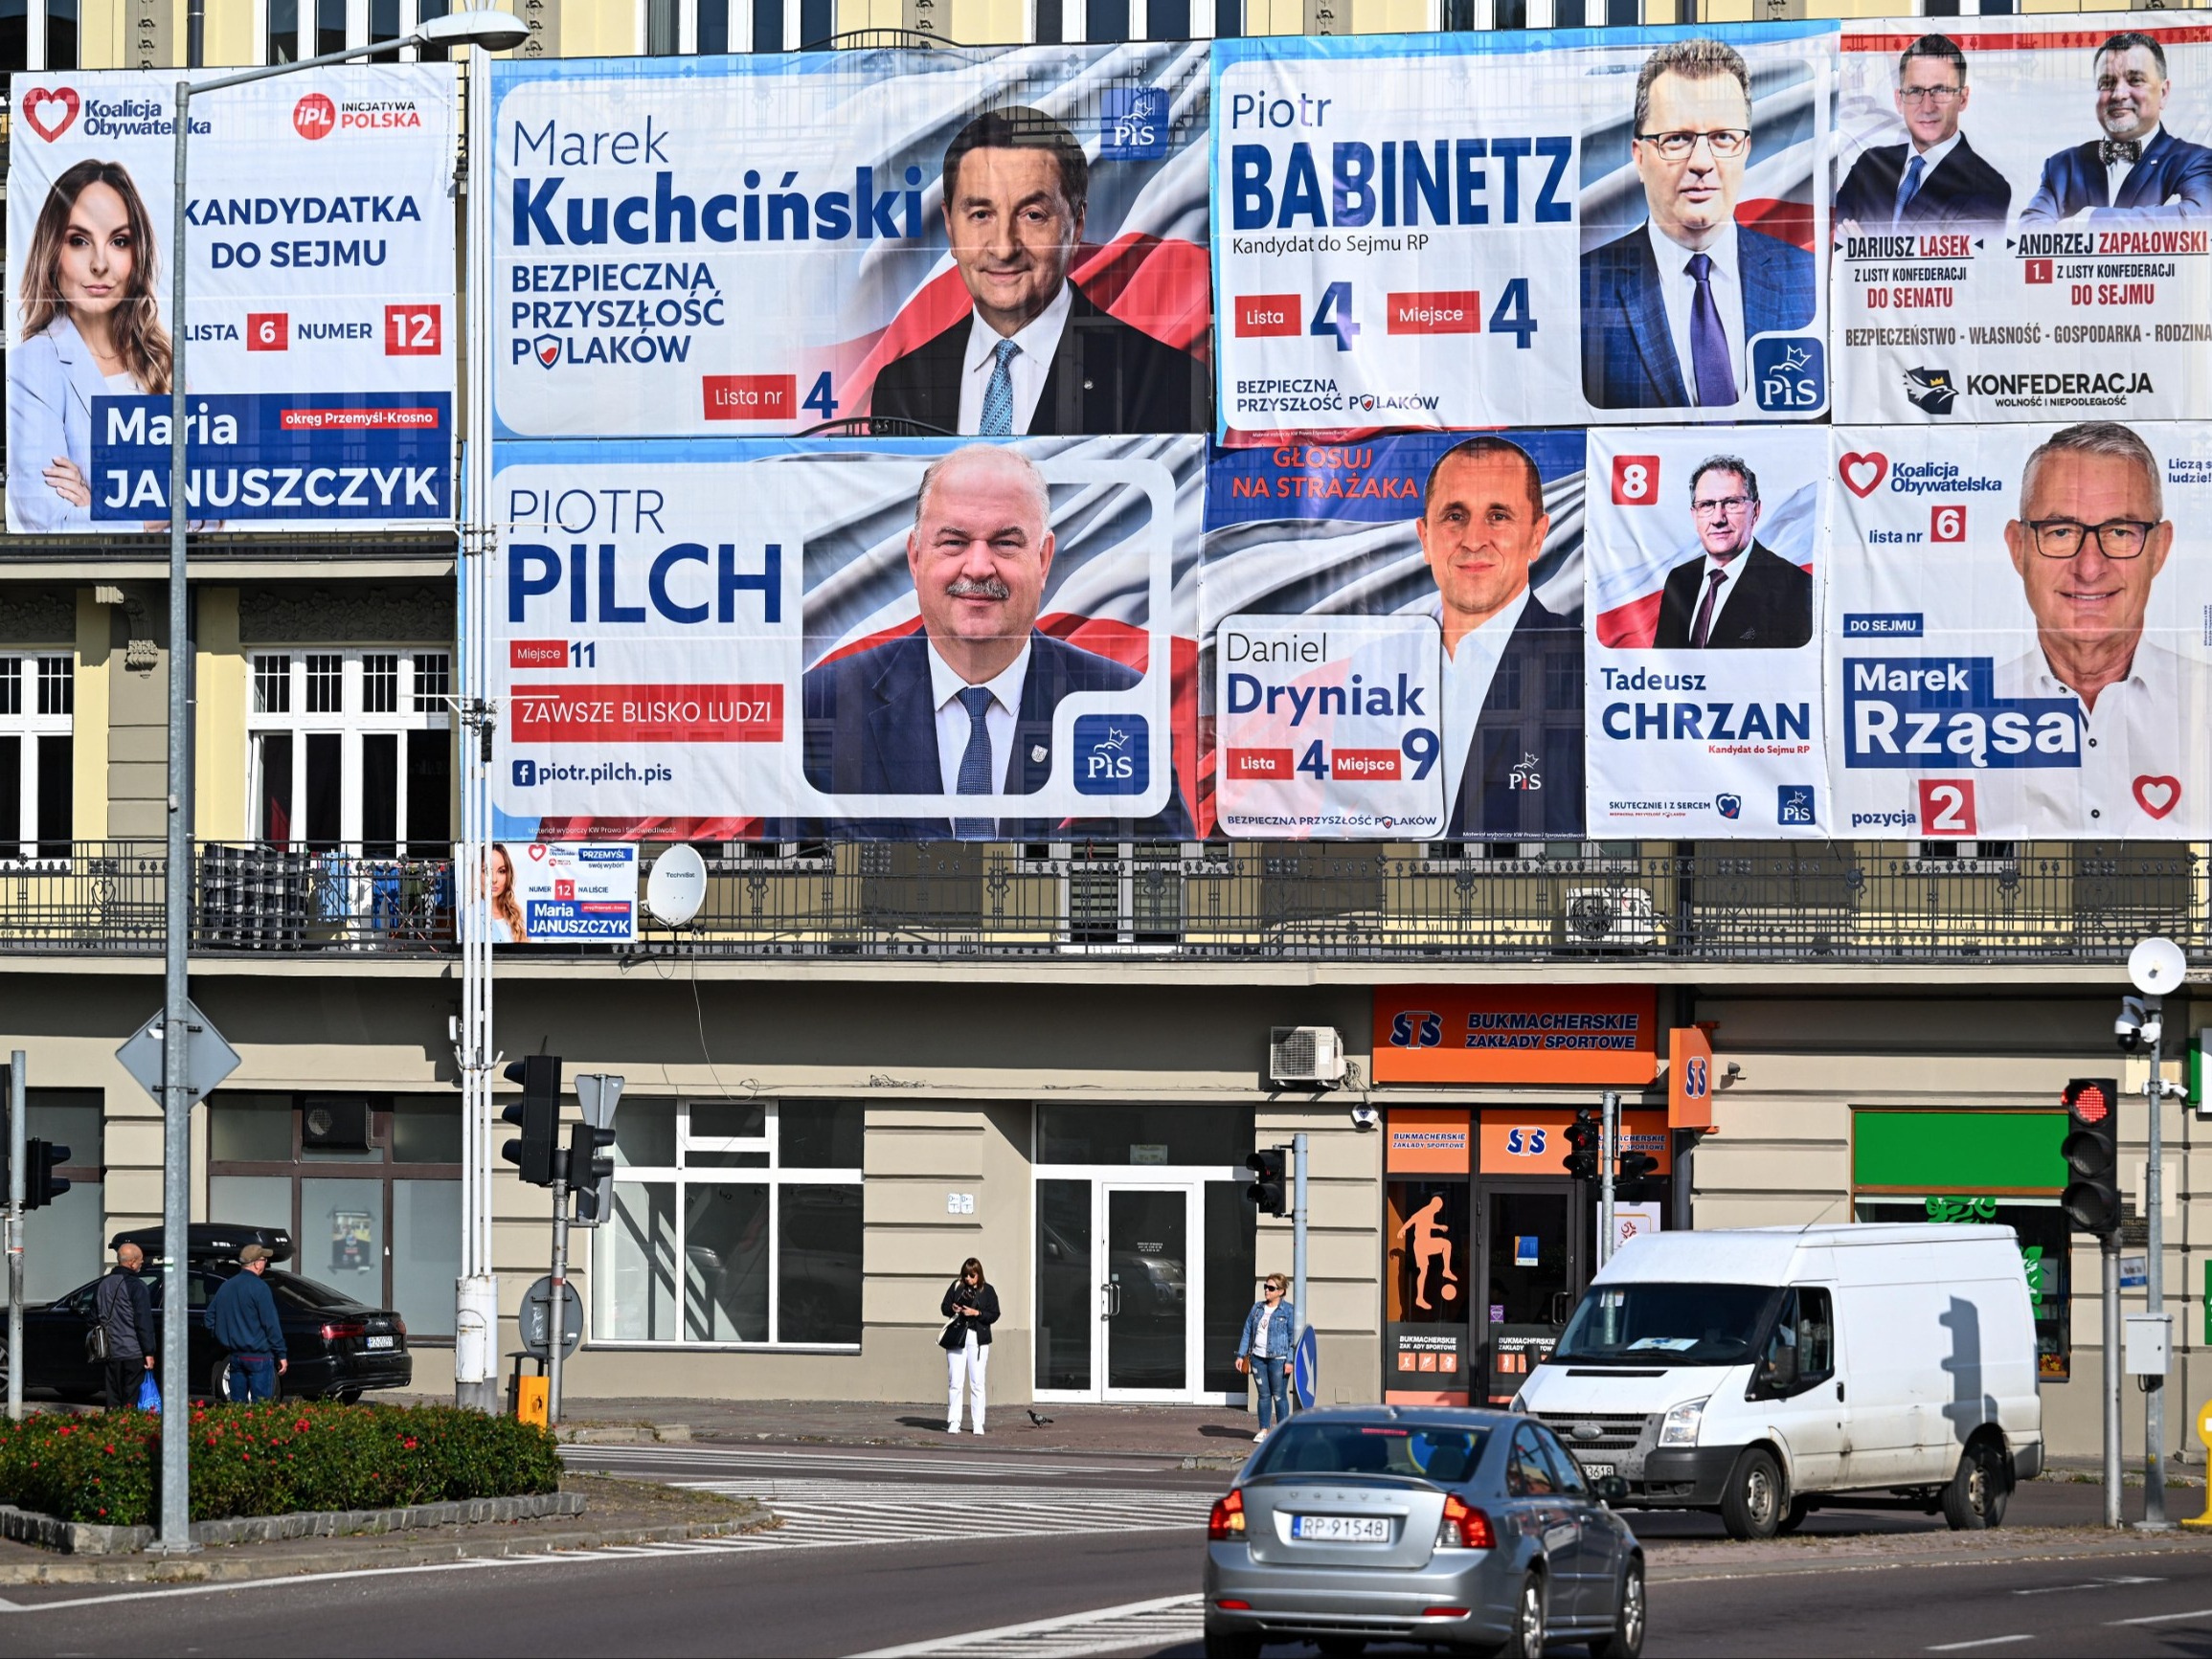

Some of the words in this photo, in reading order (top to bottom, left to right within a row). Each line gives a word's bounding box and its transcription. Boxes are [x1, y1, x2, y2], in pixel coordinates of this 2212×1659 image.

[85, 100, 162, 121] Koalicja
[297, 107, 332, 126] iPL
[342, 101, 416, 112] INICJATYWA
[1232, 90, 1332, 129] Piotr
[84, 117, 212, 139] Obywatelka
[342, 112, 421, 128] POLSKA
[513, 115, 669, 167] Marek
[1232, 136, 1572, 230] BABINETZ
[185, 195, 421, 226] KANDYDATKA
[512, 166, 922, 246] Kuchciński
[212, 241, 260, 269] DO
[270, 239, 386, 267] SEJMU
[1233, 236, 1314, 257] Kandydat
[1319, 235, 1341, 252] do
[1347, 235, 1401, 255] Sejmu
[1408, 235, 1429, 250] RP
[1847, 235, 1915, 258] DARIUSZ
[1920, 235, 1970, 257] LASEK
[2018, 233, 2093, 255] ANDRZEJ
[2099, 231, 2207, 254] ZAPAŁOWSKI
[512, 262, 716, 292] BEZPIECZNA
[1855, 268, 1861, 281] Z
[1862, 268, 1889, 281] LISTY
[1892, 267, 1967, 281] KONFEDERACJI
[2057, 265, 2064, 279] Z
[2066, 265, 2094, 279] LISTY
[2097, 263, 2175, 278] KONFEDERACJI
[1867, 288, 1887, 308] DO
[1893, 287, 1952, 308] SENATU
[2071, 284, 2092, 305] DO
[2098, 283, 2155, 304] SEJMU
[512, 289, 725, 328] PRZYSZŁOŚĆ
[1247, 310, 1284, 325] Lista
[1310, 281, 1361, 351] 4
[1399, 308, 1464, 325] Miejsce
[1489, 278, 1538, 349] 4
[185, 324, 239, 342] LISTA
[260, 321, 276, 344] 6
[298, 323, 372, 340] NUMER
[392, 313, 434, 347] 12
[1846, 325, 1955, 347] BEZPIECZEŃSTWO
[1969, 323, 2041, 345] WŁASNOŚĆ
[2054, 325, 2141, 344] GOSPODARKA
[2155, 324, 2212, 343] RODZINA
[715, 388, 758, 407] Lista
[764, 391, 783, 405] nr
[801, 371, 839, 419] 4
[1237, 379, 1338, 393] BEZPIECZNA
[1763, 379, 1817, 405] PiS
[1967, 372, 2154, 395] KONFEDERACJA
[1237, 394, 1343, 413] PRZYSZŁOŚĆ
[1996, 395, 2042, 407] WOLNOŚĆ
[2050, 395, 2127, 406] NIEPODLEGŁOŚĆ
[107, 402, 237, 445] Maria
[285, 413, 322, 427] okręg
[325, 412, 433, 426] Przemyśl-Krosno
[1273, 446, 1373, 469] GŁOSUJ
[2169, 459, 2202, 471] Liczą
[1622, 464, 1647, 499] 8
[1892, 461, 1959, 480] Koalicja
[2169, 473, 2211, 482] ludzie!
[104, 466, 438, 508] JANUSZCZYK
[1232, 477, 1270, 499] NA
[1276, 473, 1419, 499] STRAŻAKA
[1890, 476, 2002, 496] Obywatelska
[509, 489, 665, 534] PIOTR
[1869, 529, 1903, 544] lista
[1907, 532, 1923, 543] nr
[1937, 509, 1960, 539] 6
[508, 543, 781, 623] PILCH
[1850, 620, 1870, 632] DO
[1872, 619, 1916, 632] SEJMU
[517, 648, 560, 662] Miejsce
[570, 641, 596, 668] 11
[1227, 632, 1326, 662] Daniel
[1600, 666, 1706, 691] Tadeusz
[1854, 663, 1969, 692] Marek
[1227, 673, 1426, 727] Dryniak
[523, 702, 614, 723] ZAWSZE
[622, 702, 700, 723] BLISKO
[709, 702, 771, 723] LUDZI
[1602, 703, 1810, 741] CHRZAN
[1854, 700, 2077, 768] Rząsa
[1241, 757, 1275, 771] Lista
[1297, 739, 1329, 780] 4
[1337, 758, 1395, 773] Miejsce
[1401, 728, 1440, 780] 9
[1708, 745, 1751, 755] Kandydat
[1754, 745, 1765, 753] do
[1767, 745, 1795, 755] Sejmu
[539, 763, 672, 786] piotr.pilch.pis
[1088, 755, 1133, 778] PiS
[1509, 773, 1542, 790] PiS
[1783, 807, 1811, 820] PiS
[1852, 810, 1916, 827] pozycja
[1930, 786, 1966, 830] 2
[1228, 817, 1297, 825] BEZPIECZNA
[1299, 816, 1371, 826] PRZYSZŁOŚĆ
[582, 849, 625, 859] PRZEMYŚL
[557, 886, 572, 896] 12
[534, 903, 574, 916] Maria
[529, 920, 629, 933] JANUSZCZYK
[1390, 1011, 1442, 1049] STS
[1467, 1013, 1639, 1031] BUKMACHERSKIE
[1465, 1034, 1542, 1049] ZAKŁADY
[1544, 1034, 1636, 1050] SPORTOWE
[1684, 1057, 1707, 1099] STS
[1506, 1126, 1546, 1156] STS
[1303, 1518, 1325, 1534] RP
[1332, 1519, 1383, 1536] 91548
